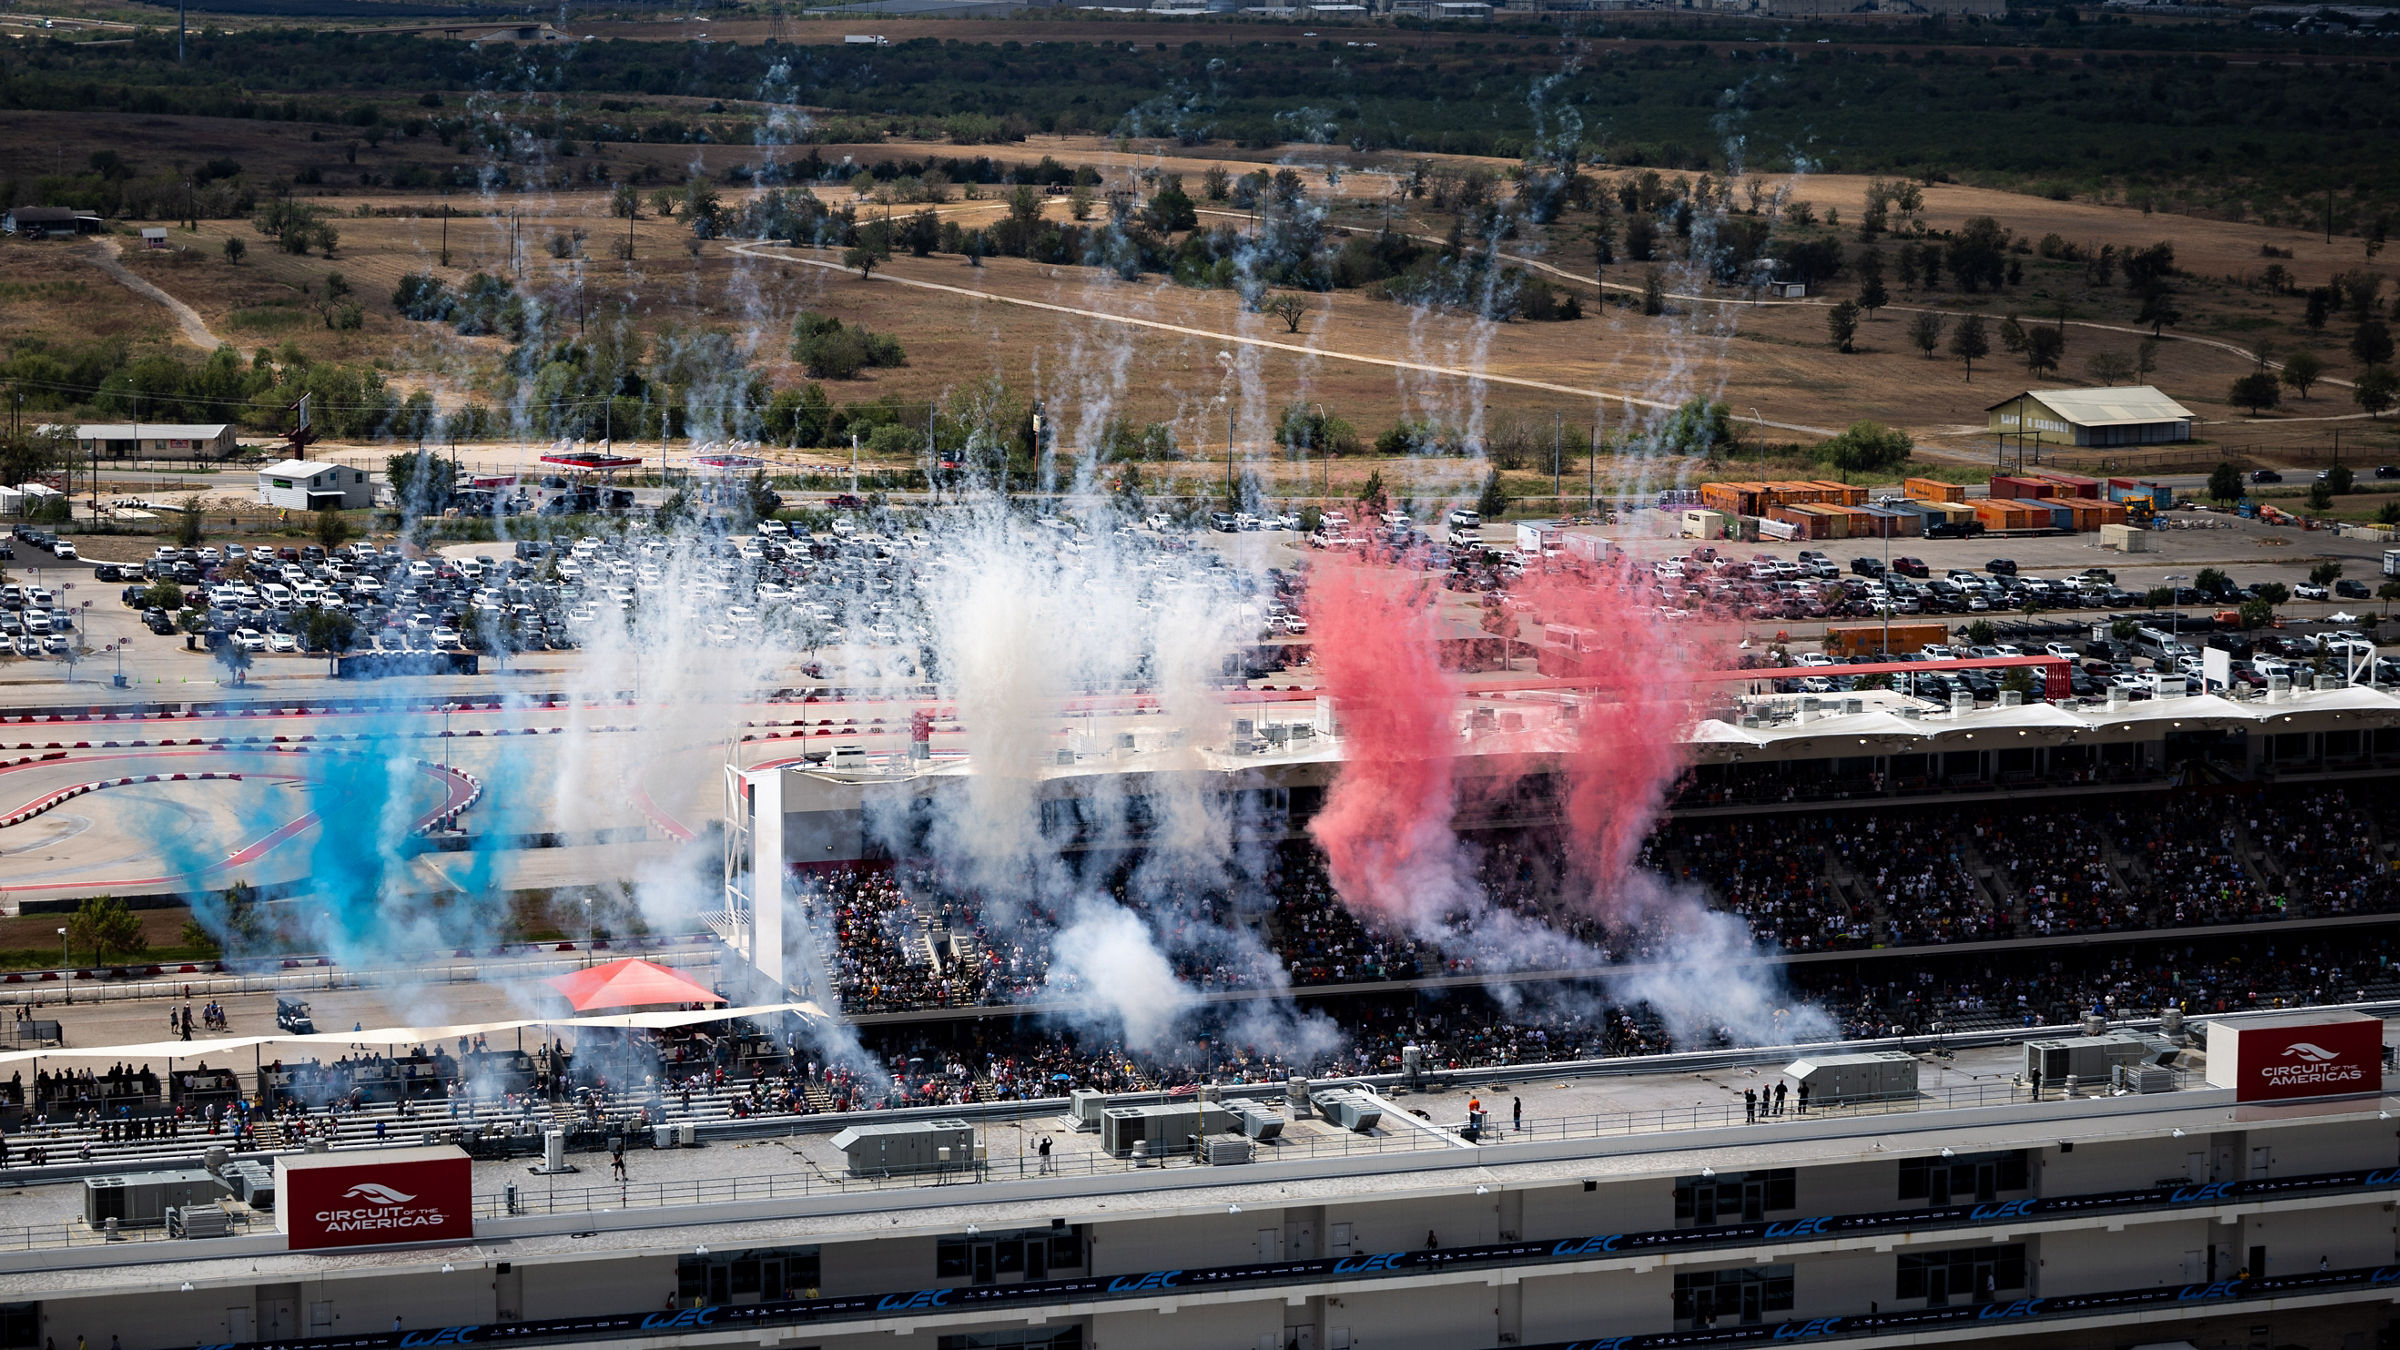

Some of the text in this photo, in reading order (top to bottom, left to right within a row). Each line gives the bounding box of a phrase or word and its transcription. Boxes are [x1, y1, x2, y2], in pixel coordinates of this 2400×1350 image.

[2262, 1063, 2331, 1076] CIRCUIT
[2269, 1070, 2361, 1086] AMERICAS
[2170, 1181, 2236, 1203] WEC
[315, 1206, 404, 1222] CIRCUIT
[1971, 1199, 2036, 1219] WEC
[325, 1214, 444, 1232] AMERICAS
[1765, 1216, 1833, 1238] WEC
[1553, 1234, 1623, 1256] WEC
[1333, 1252, 1405, 1274] WEC
[1108, 1270, 1182, 1292] WEC
[2178, 1280, 2242, 1300] WEC
[877, 1289, 952, 1311] WEC
[1978, 1299, 2044, 1319] WEC
[641, 1307, 718, 1329] WEC
[1773, 1317, 1842, 1339] WEC
[400, 1326, 478, 1348] WEC
